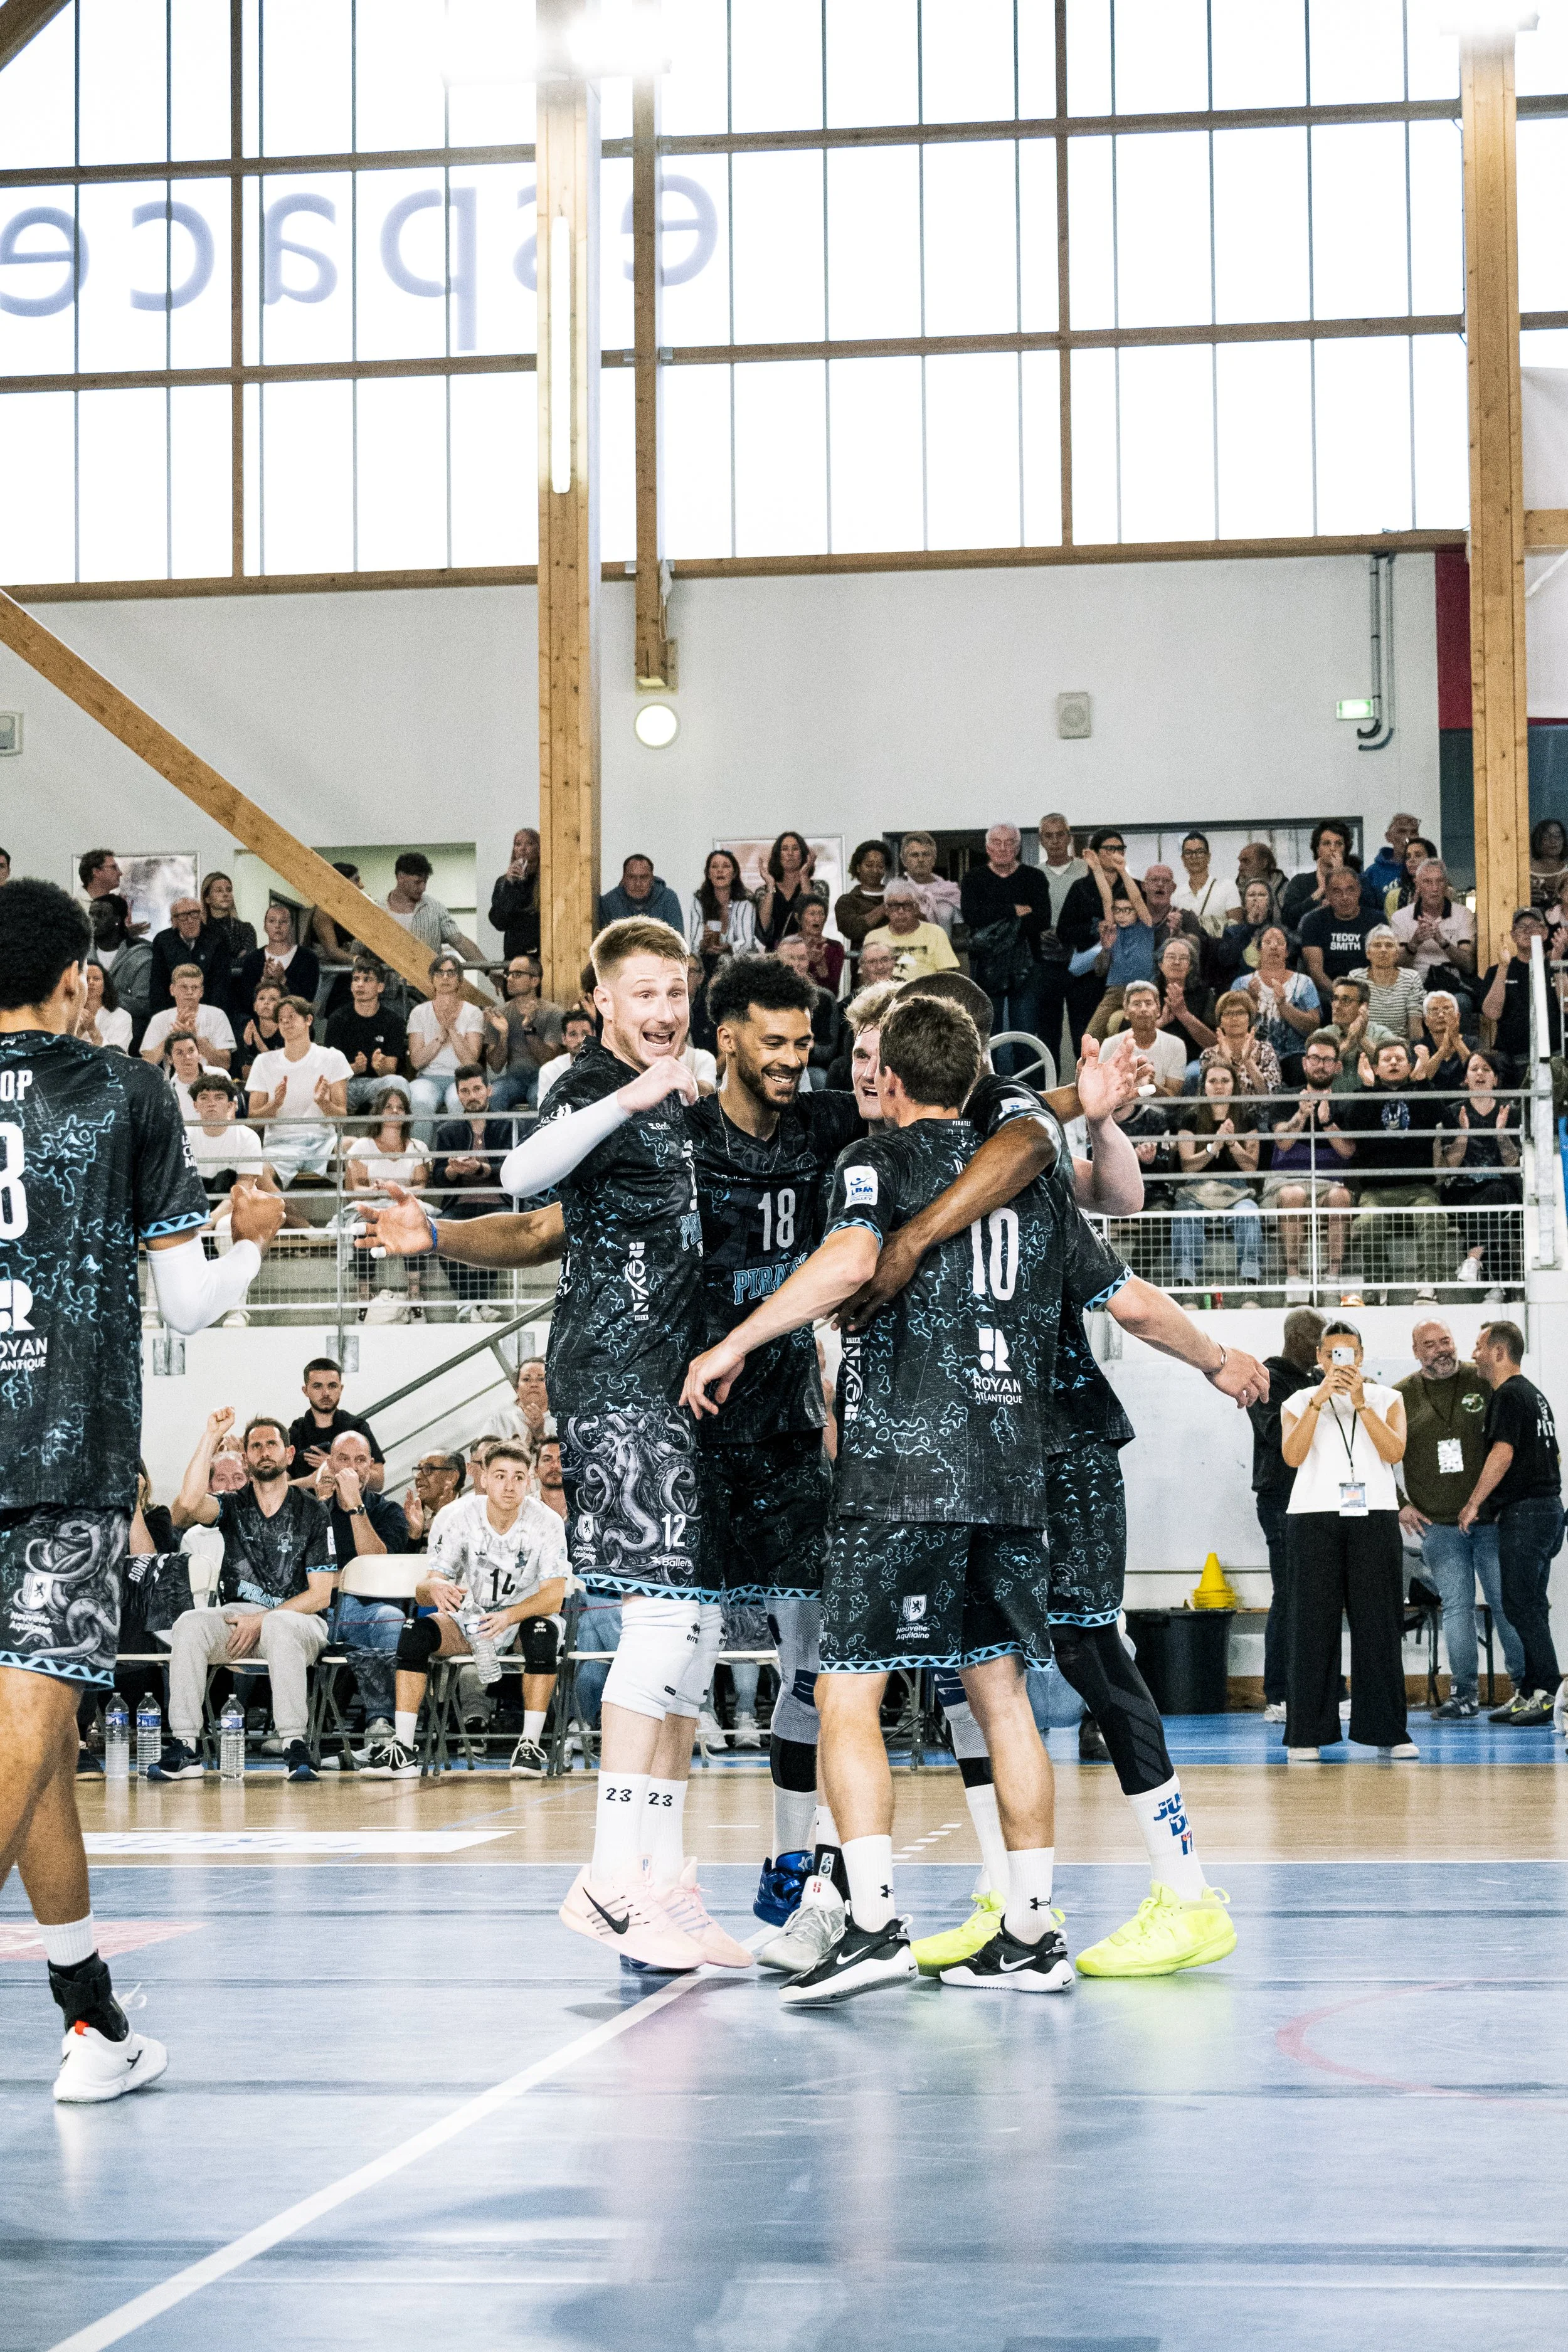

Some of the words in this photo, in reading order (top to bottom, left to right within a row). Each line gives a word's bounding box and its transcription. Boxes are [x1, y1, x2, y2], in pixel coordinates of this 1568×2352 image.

[1331, 933, 1361, 941] TEDDY
[1330, 941, 1361, 951] SMITH
[0, 1070, 33, 1102] OP
[851, 1187, 873, 1195] LBM
[758, 1189, 795, 1251] 18
[972, 1207, 1019, 1301] 10
[973, 1376, 1022, 1393] ROYAN
[975, 1391, 1023, 1405] ATLANTIQUE
[662, 1513, 686, 1547] 12
[662, 1558, 691, 1567] Ballers
[490, 1569, 516, 1601] 14
[896, 1625, 930, 1634] Nouvelle-
[606, 1788, 632, 1802] 23
[649, 1793, 673, 1807] 23
[1154, 1793, 1182, 1821] JU
[1169, 1814, 1187, 1836] D
